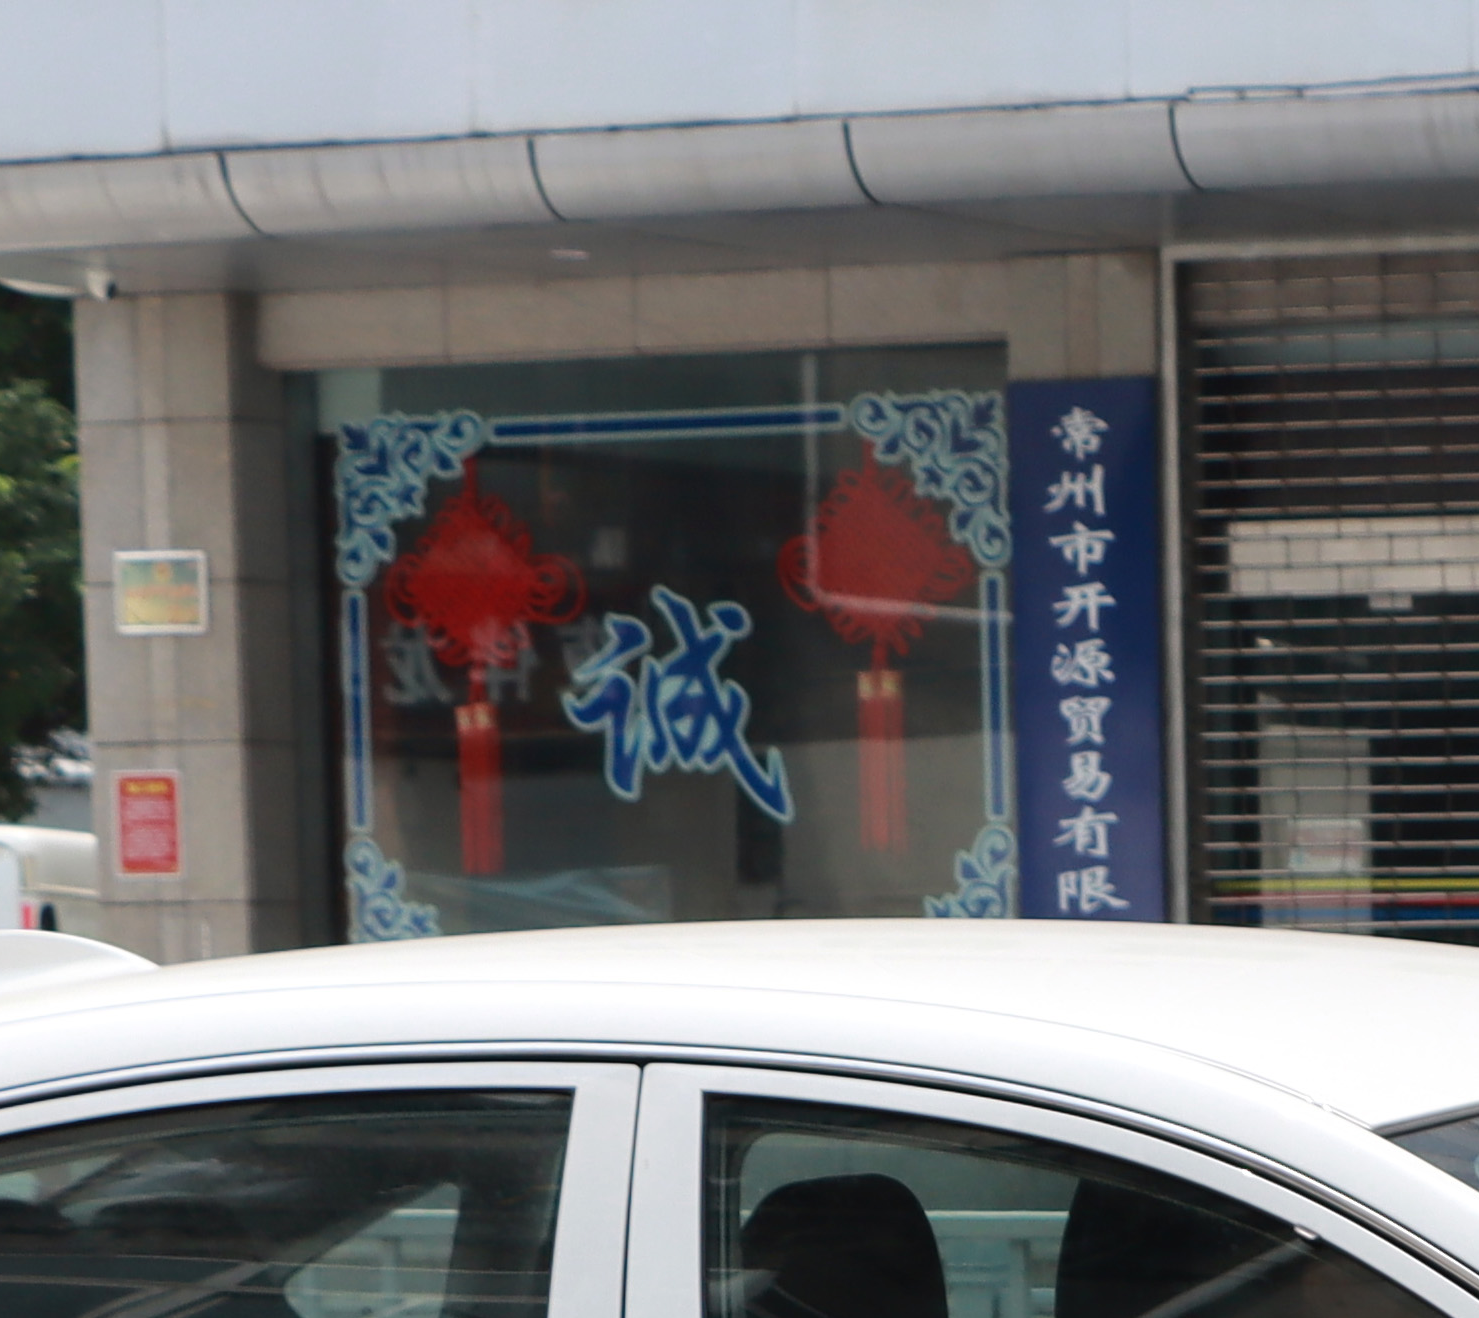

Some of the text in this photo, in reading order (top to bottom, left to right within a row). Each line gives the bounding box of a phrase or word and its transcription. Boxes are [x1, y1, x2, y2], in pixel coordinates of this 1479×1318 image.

[561, 584, 795, 823] 诚
[1043, 406, 1129, 914] 常州市开源贸易有限
